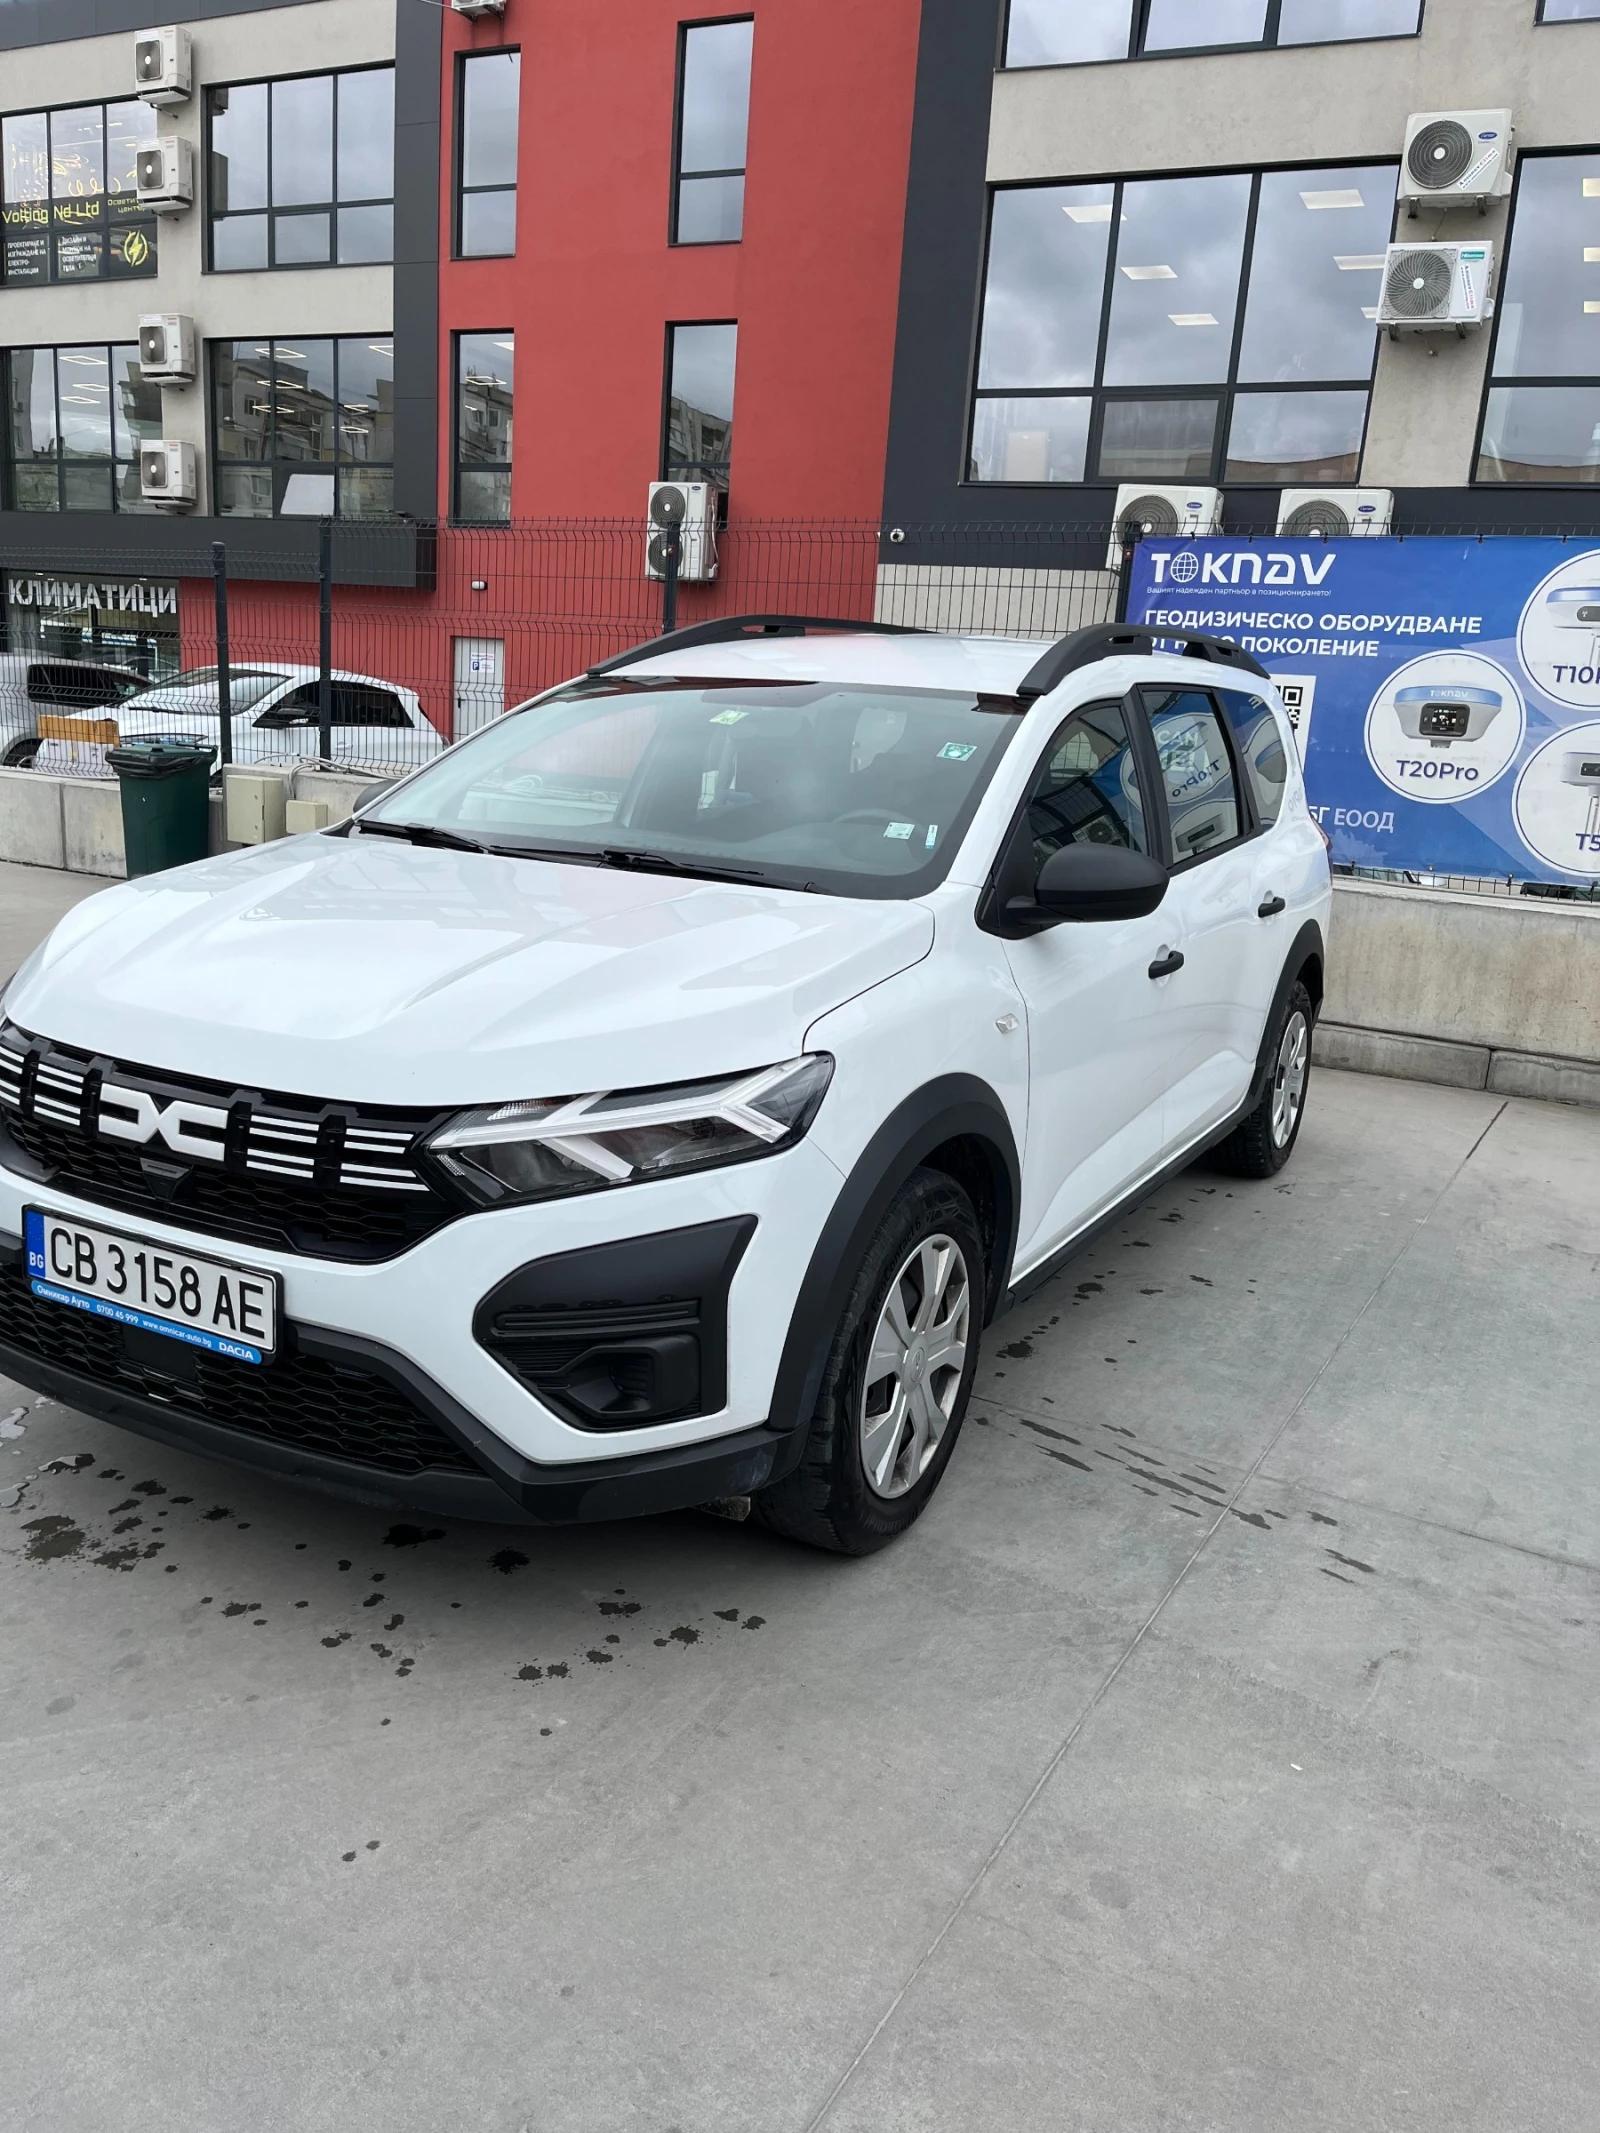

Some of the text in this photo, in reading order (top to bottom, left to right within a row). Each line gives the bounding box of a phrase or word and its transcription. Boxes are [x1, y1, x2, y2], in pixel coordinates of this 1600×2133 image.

[76, 201, 100, 217] Ltd
[8, 240, 39, 248] ПРОЕКТИРАНЕ
[8, 249, 39, 257] ИЗГРАЖДАНЕ
[8, 579, 177, 618] КЛИМАТИЦИ
[1146, 586, 1175, 594] Вашият
[1175, 587, 1213, 595] надежден
[1214, 588, 1250, 596] партньор
[1258, 589, 1331, 597] позиционирането!
[1145, 610, 1483, 635] ГЕОДИЗИЧЕСКО ОБОРУДВАНЕ
[1241, 636, 1379, 657] ПОКОЛЕНИЕ
[1396, 760, 1479, 781] T20Pro
[1334, 807, 1395, 834] ЕООД
[29, 1251, 44, 1269] BG
[106, 1243, 202, 1317] 3158
[212, 1275, 265, 1339] AE
[37, 1285, 254, 1361] Омникар Ауто 0700 45 999 www.omnicar-auto.bg DACIA
